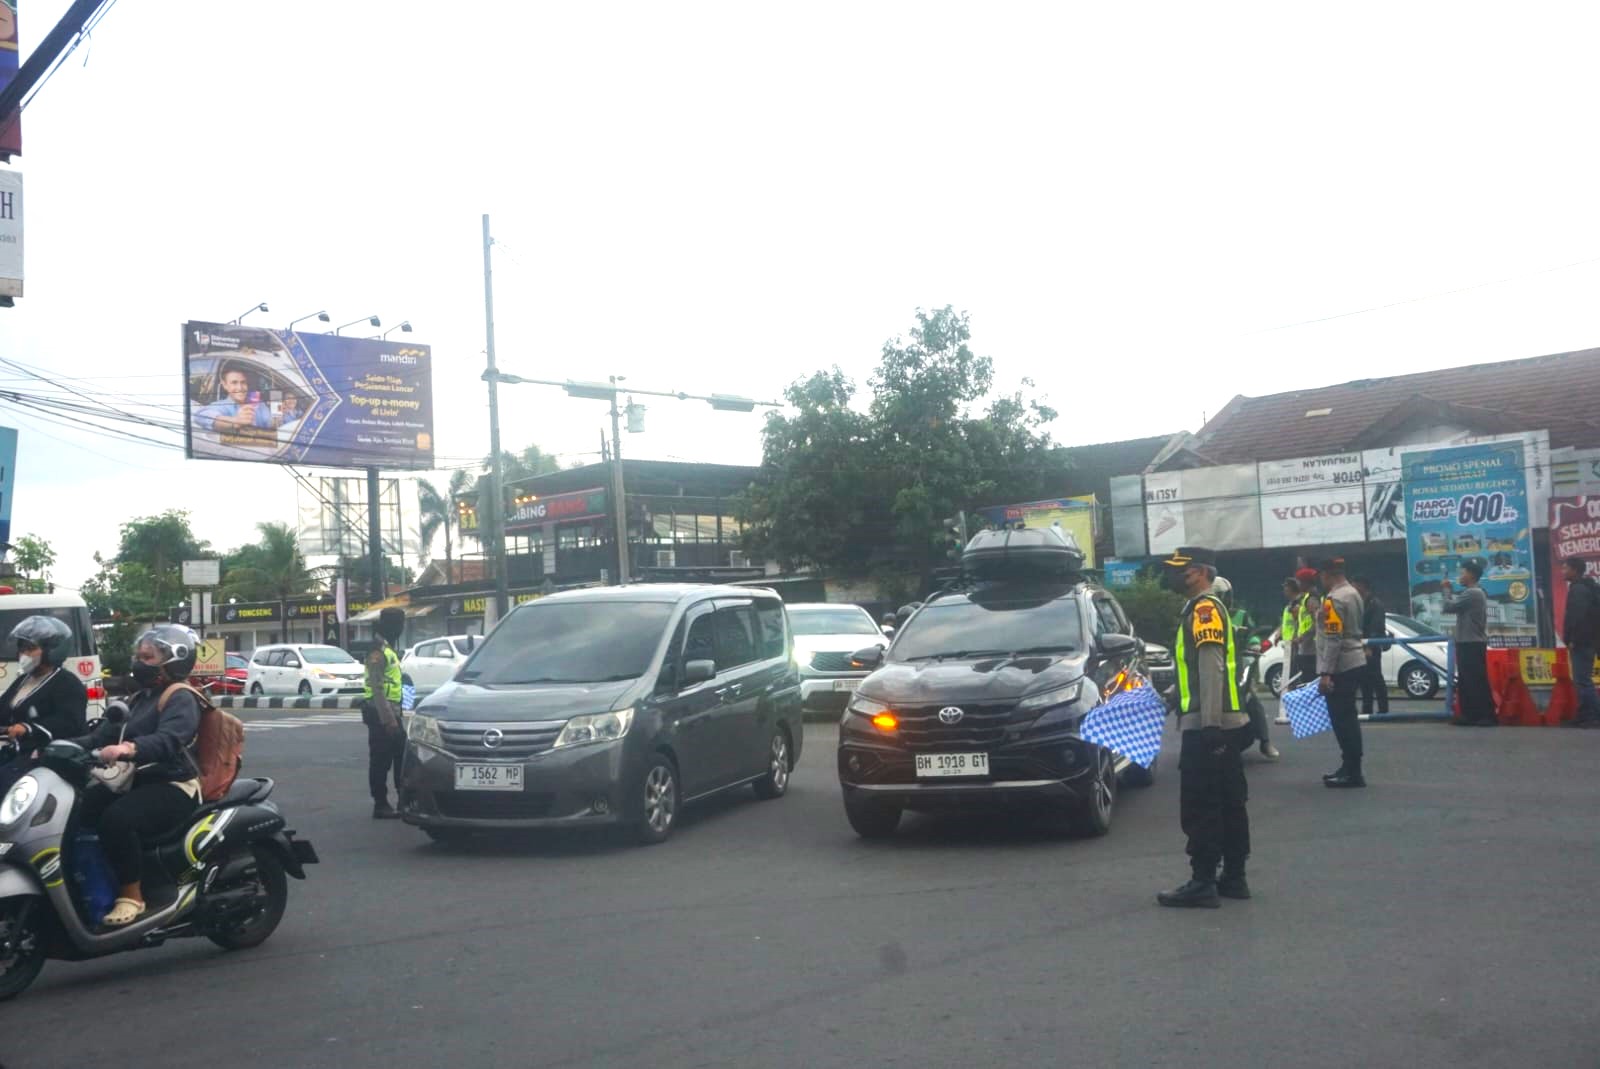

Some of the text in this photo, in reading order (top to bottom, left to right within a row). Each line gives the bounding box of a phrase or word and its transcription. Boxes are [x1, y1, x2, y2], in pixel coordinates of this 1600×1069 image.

[380, 353, 417, 365] mandiri
[350, 394, 419, 410] Top-up e-money
[1303, 455, 1358, 468] PENJUALAN
[1272, 501, 1364, 520] HONDA
[1415, 498, 1455, 511] HARGA
[1457, 492, 1504, 526] 600
[1414, 508, 1451, 520] MULAI
[917, 754, 987, 769] BH 1918 GT
[459, 766, 464, 779] T
[472, 767, 497, 780] 1562
